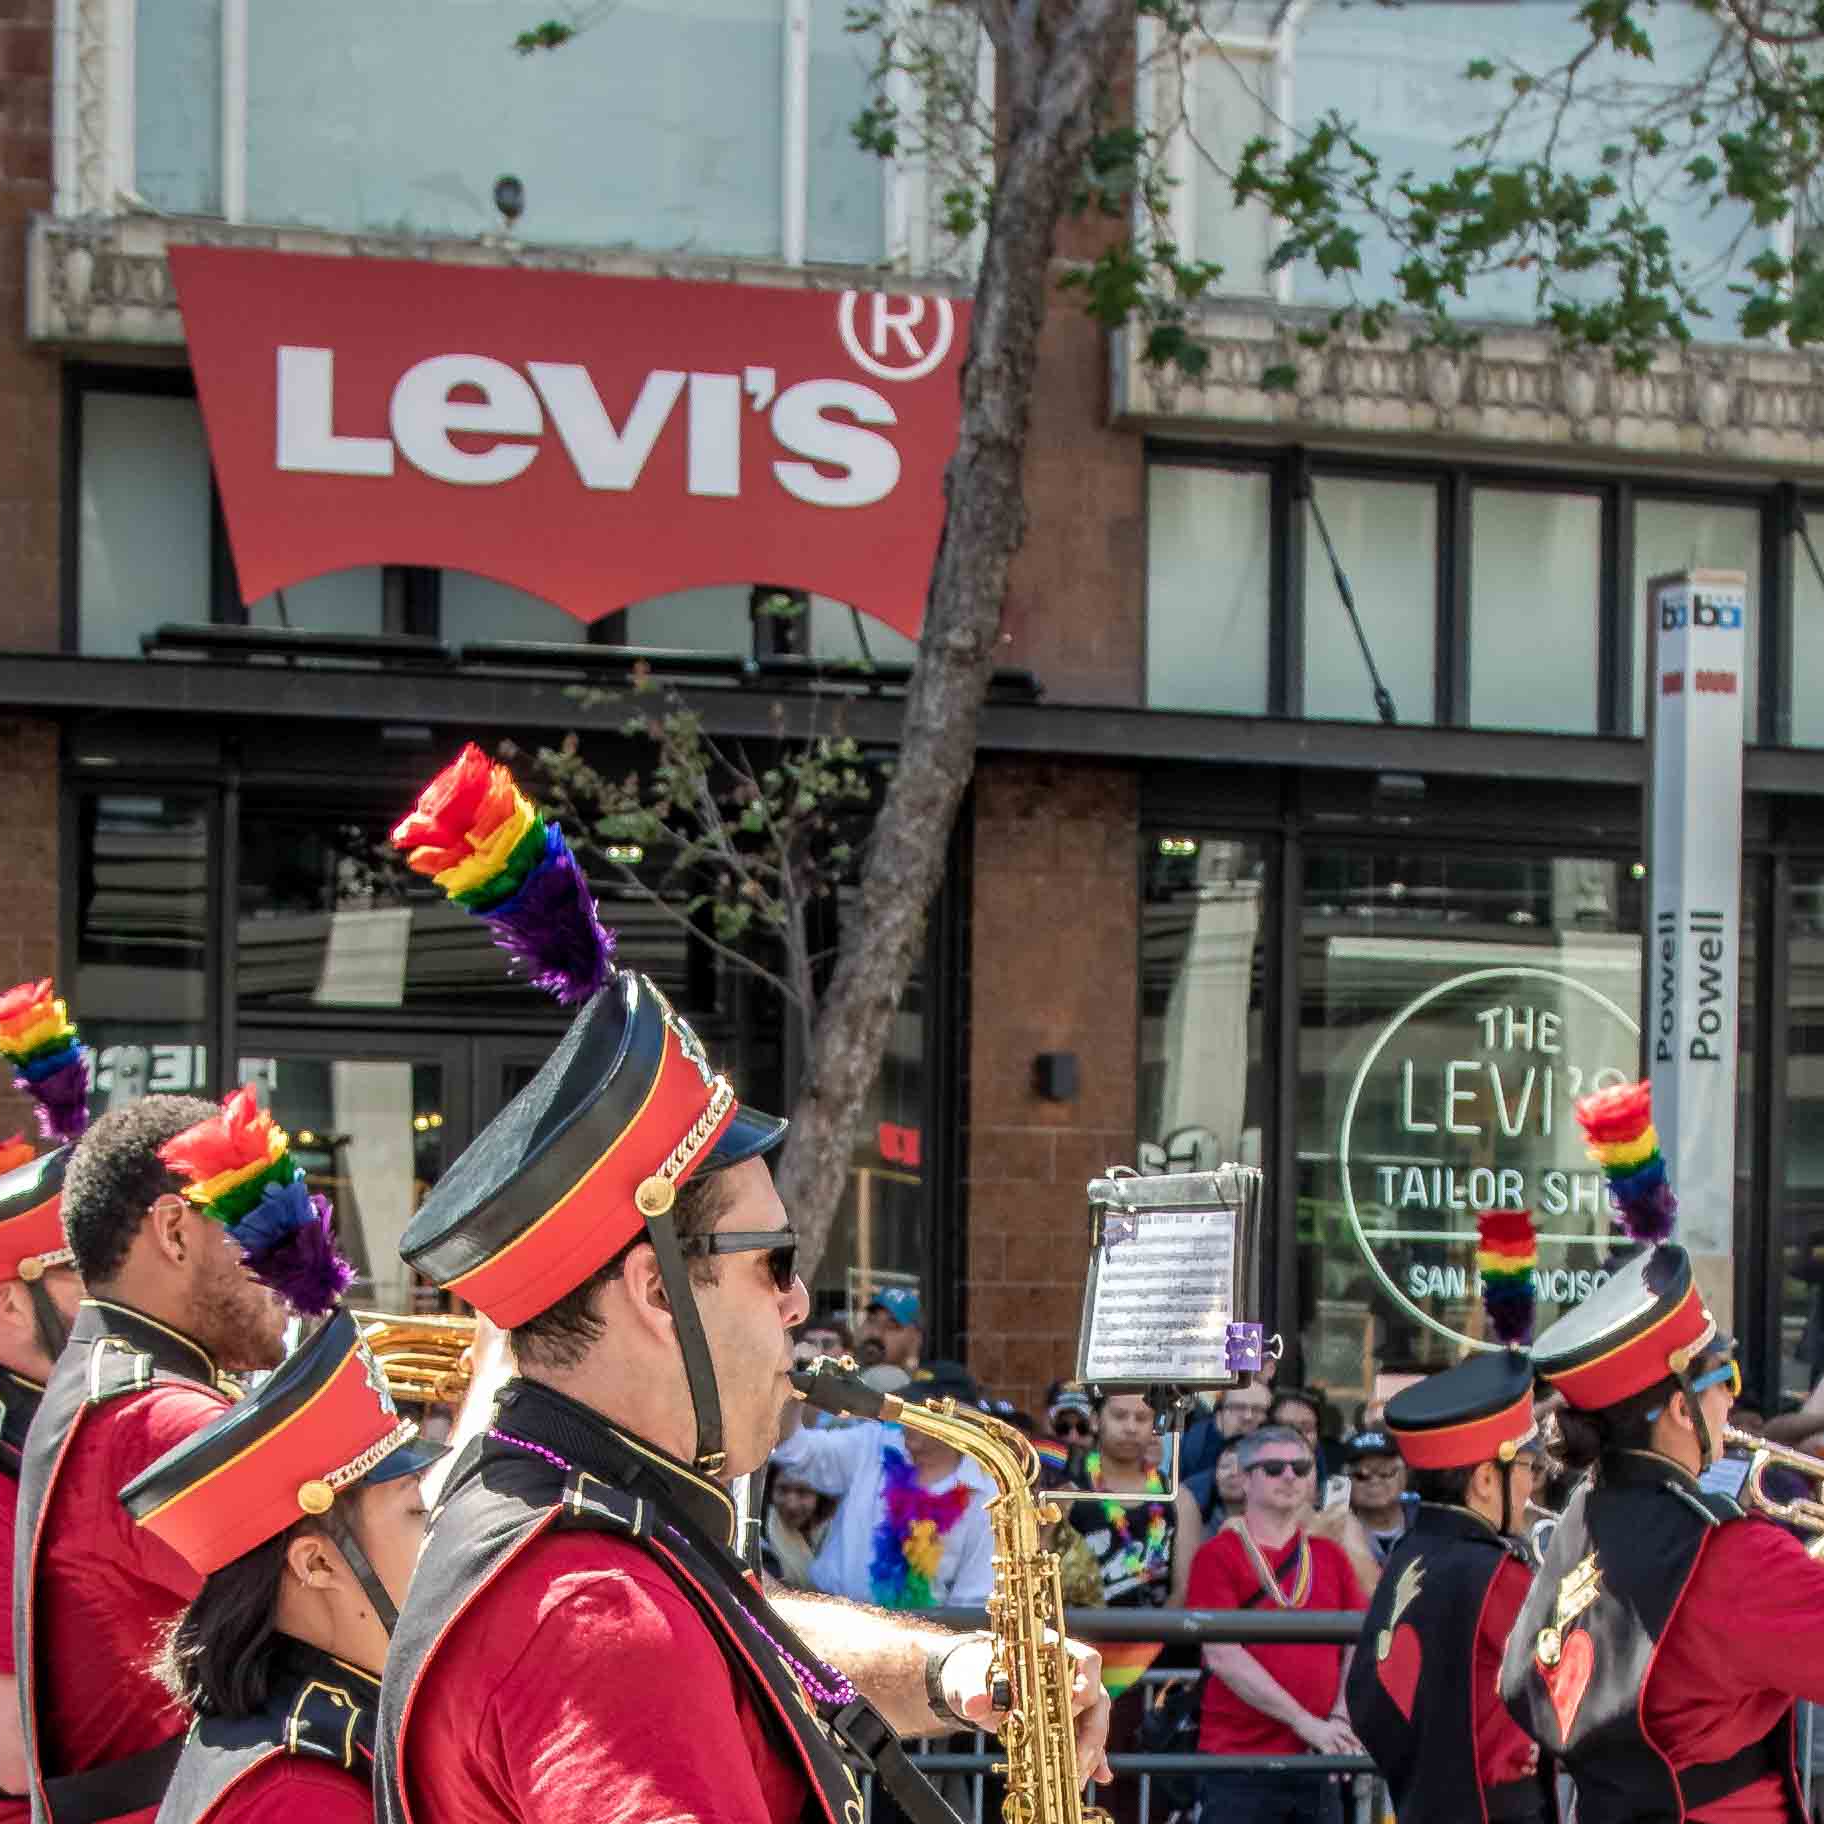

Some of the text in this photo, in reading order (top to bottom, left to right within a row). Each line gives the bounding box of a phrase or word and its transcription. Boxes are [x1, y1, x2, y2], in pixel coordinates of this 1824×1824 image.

[1656, 911, 1677, 1063] Powell
[1689, 911, 1724, 1062] Powell
[1477, 1005, 1563, 1055] THE
[1377, 1166, 1614, 1215] TAILOR SH
[1408, 1264, 1467, 1299] SAN
